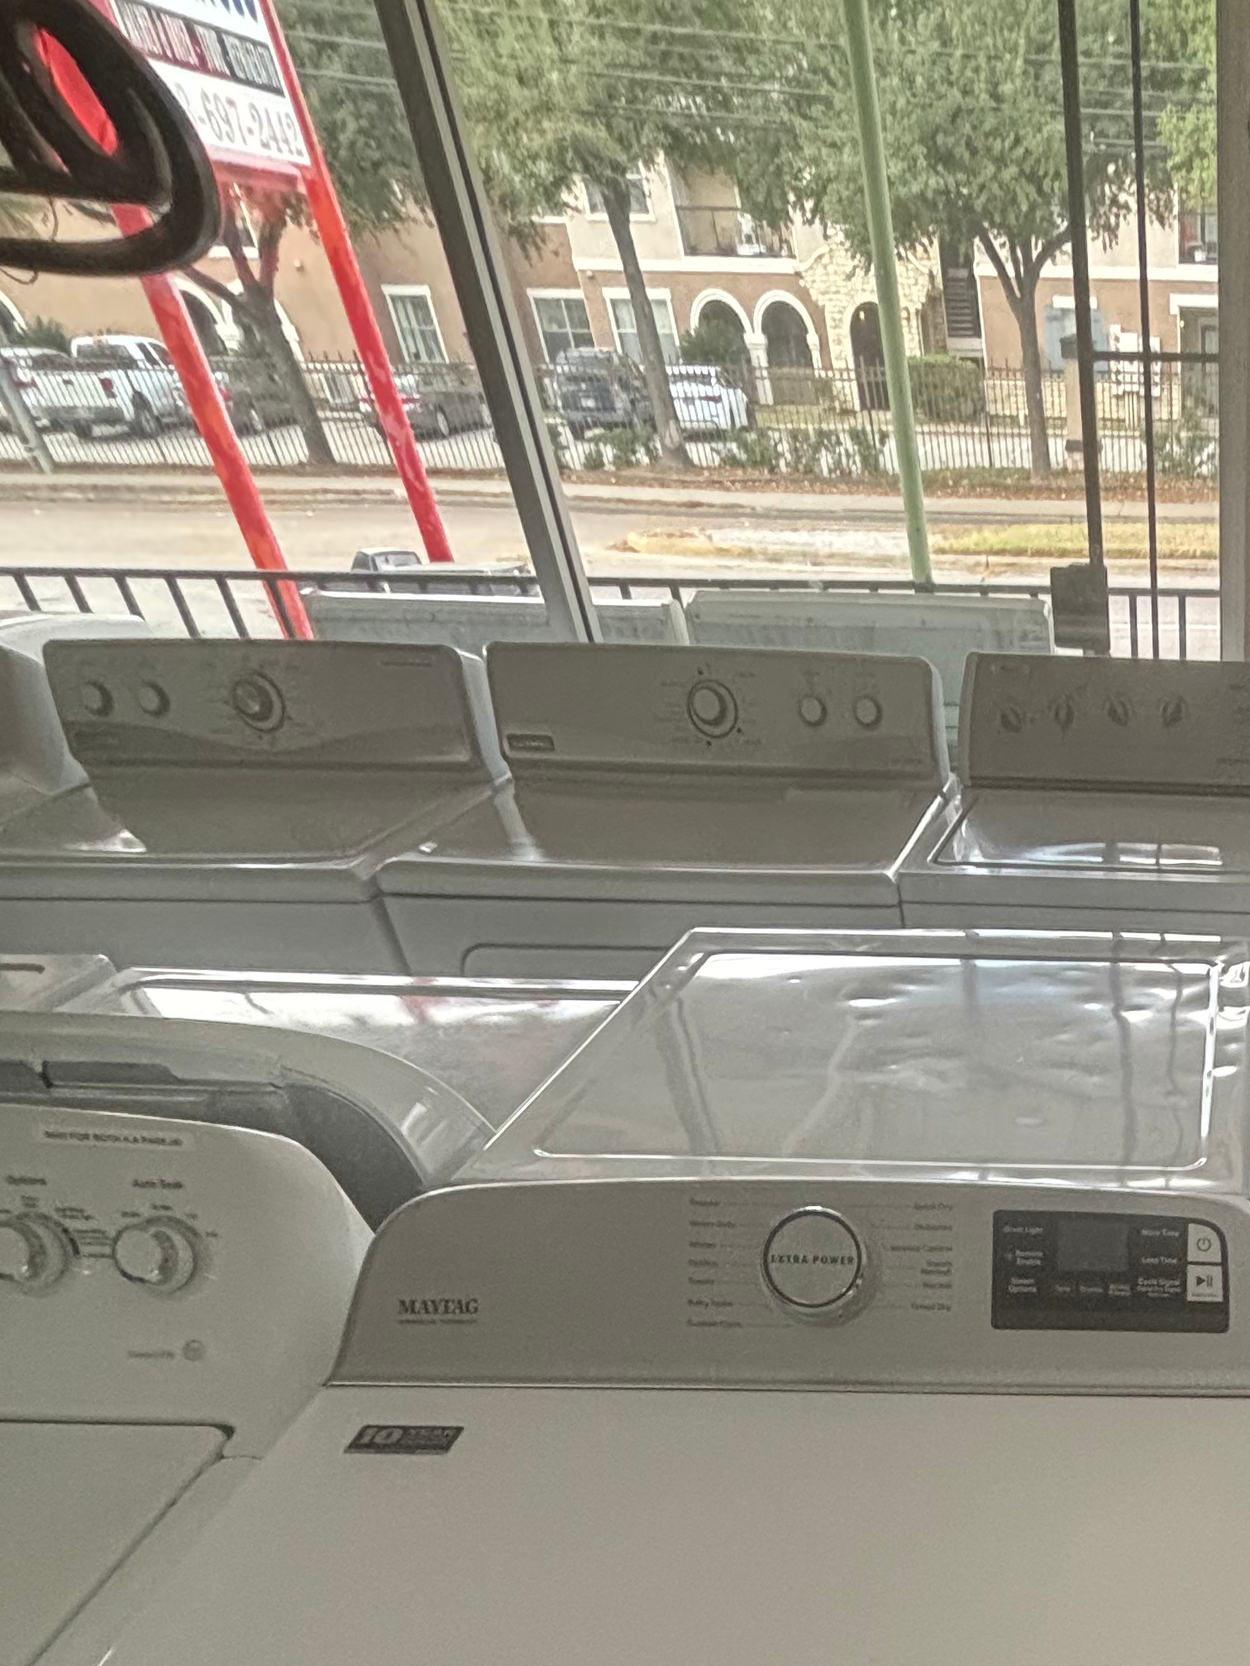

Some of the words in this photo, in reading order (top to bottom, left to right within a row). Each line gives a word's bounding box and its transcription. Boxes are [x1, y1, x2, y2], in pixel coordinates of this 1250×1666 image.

[770, 1254, 808, 1265] EXTRA
[812, 1255, 855, 1266] POWER
[398, 1298, 479, 1315] MAYTAG
